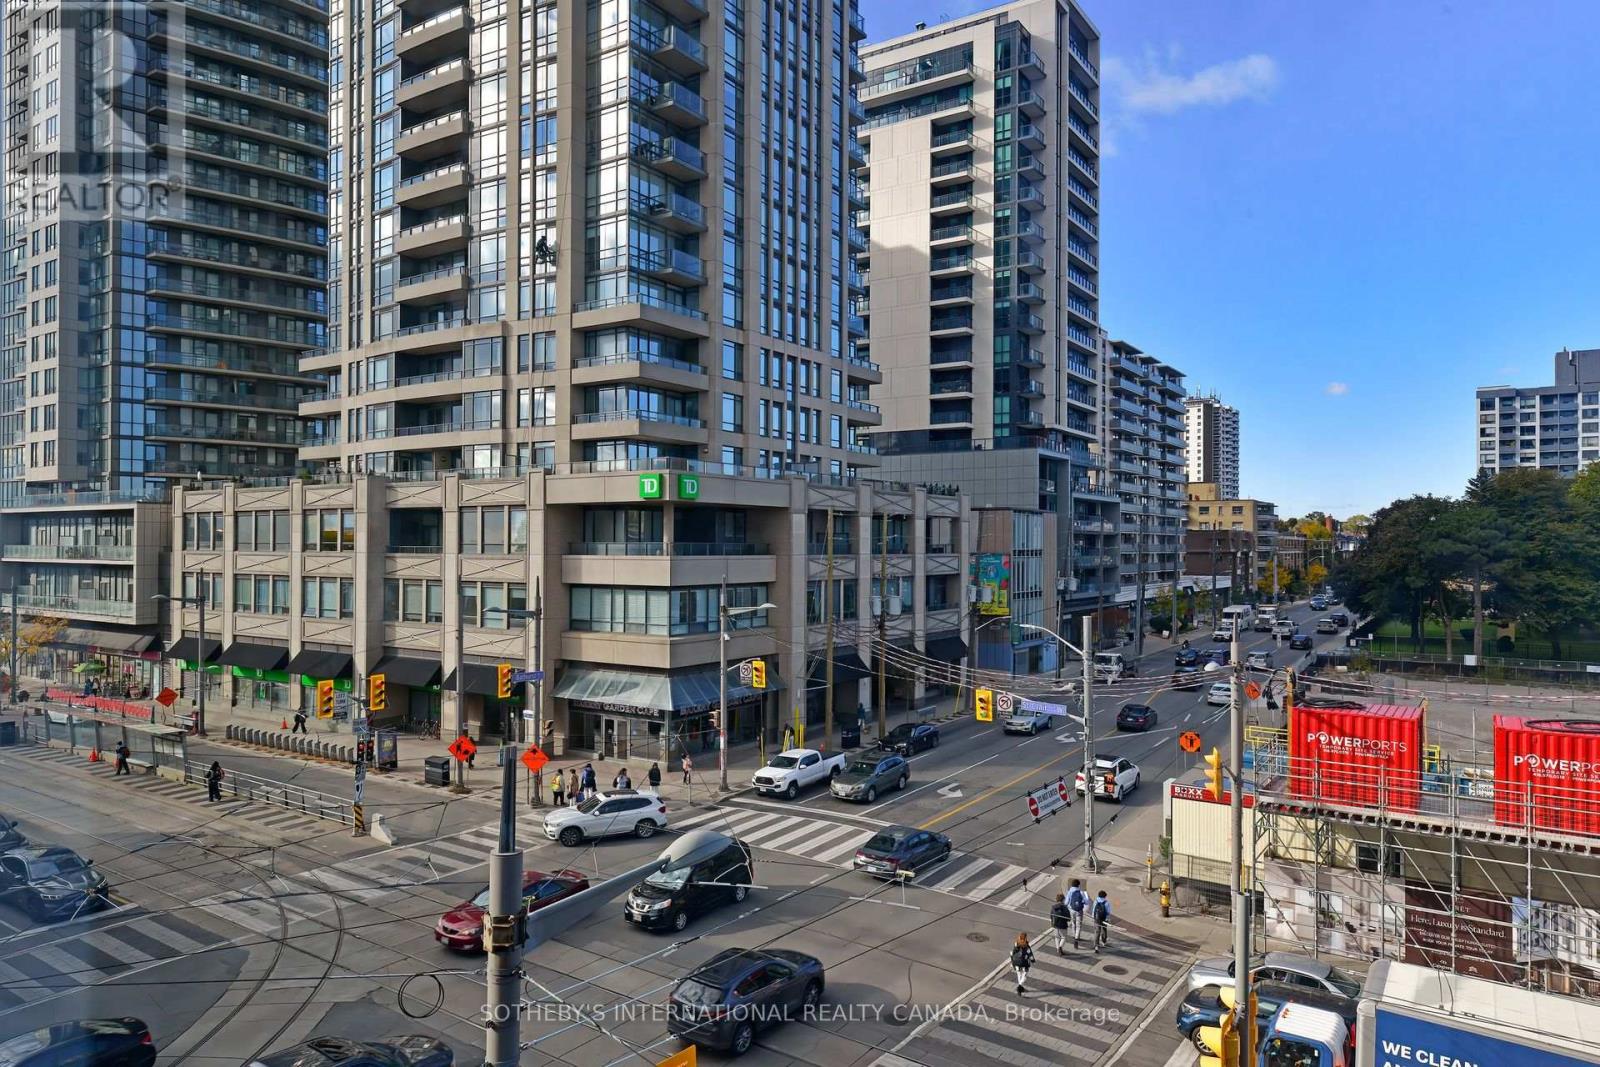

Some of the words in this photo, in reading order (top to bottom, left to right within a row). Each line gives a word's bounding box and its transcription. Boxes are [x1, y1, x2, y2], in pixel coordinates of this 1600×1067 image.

[641, 478, 657, 493] TD
[684, 479, 698, 494] TD
[1307, 731, 1408, 752] POWERPORTS
[1528, 768, 1569, 776] TEMPORARY
[1174, 786, 1203, 796] BOXX
[1433, 918, 1460, 931] Luxuy
[1381, 1040, 1412, 1060] WE
